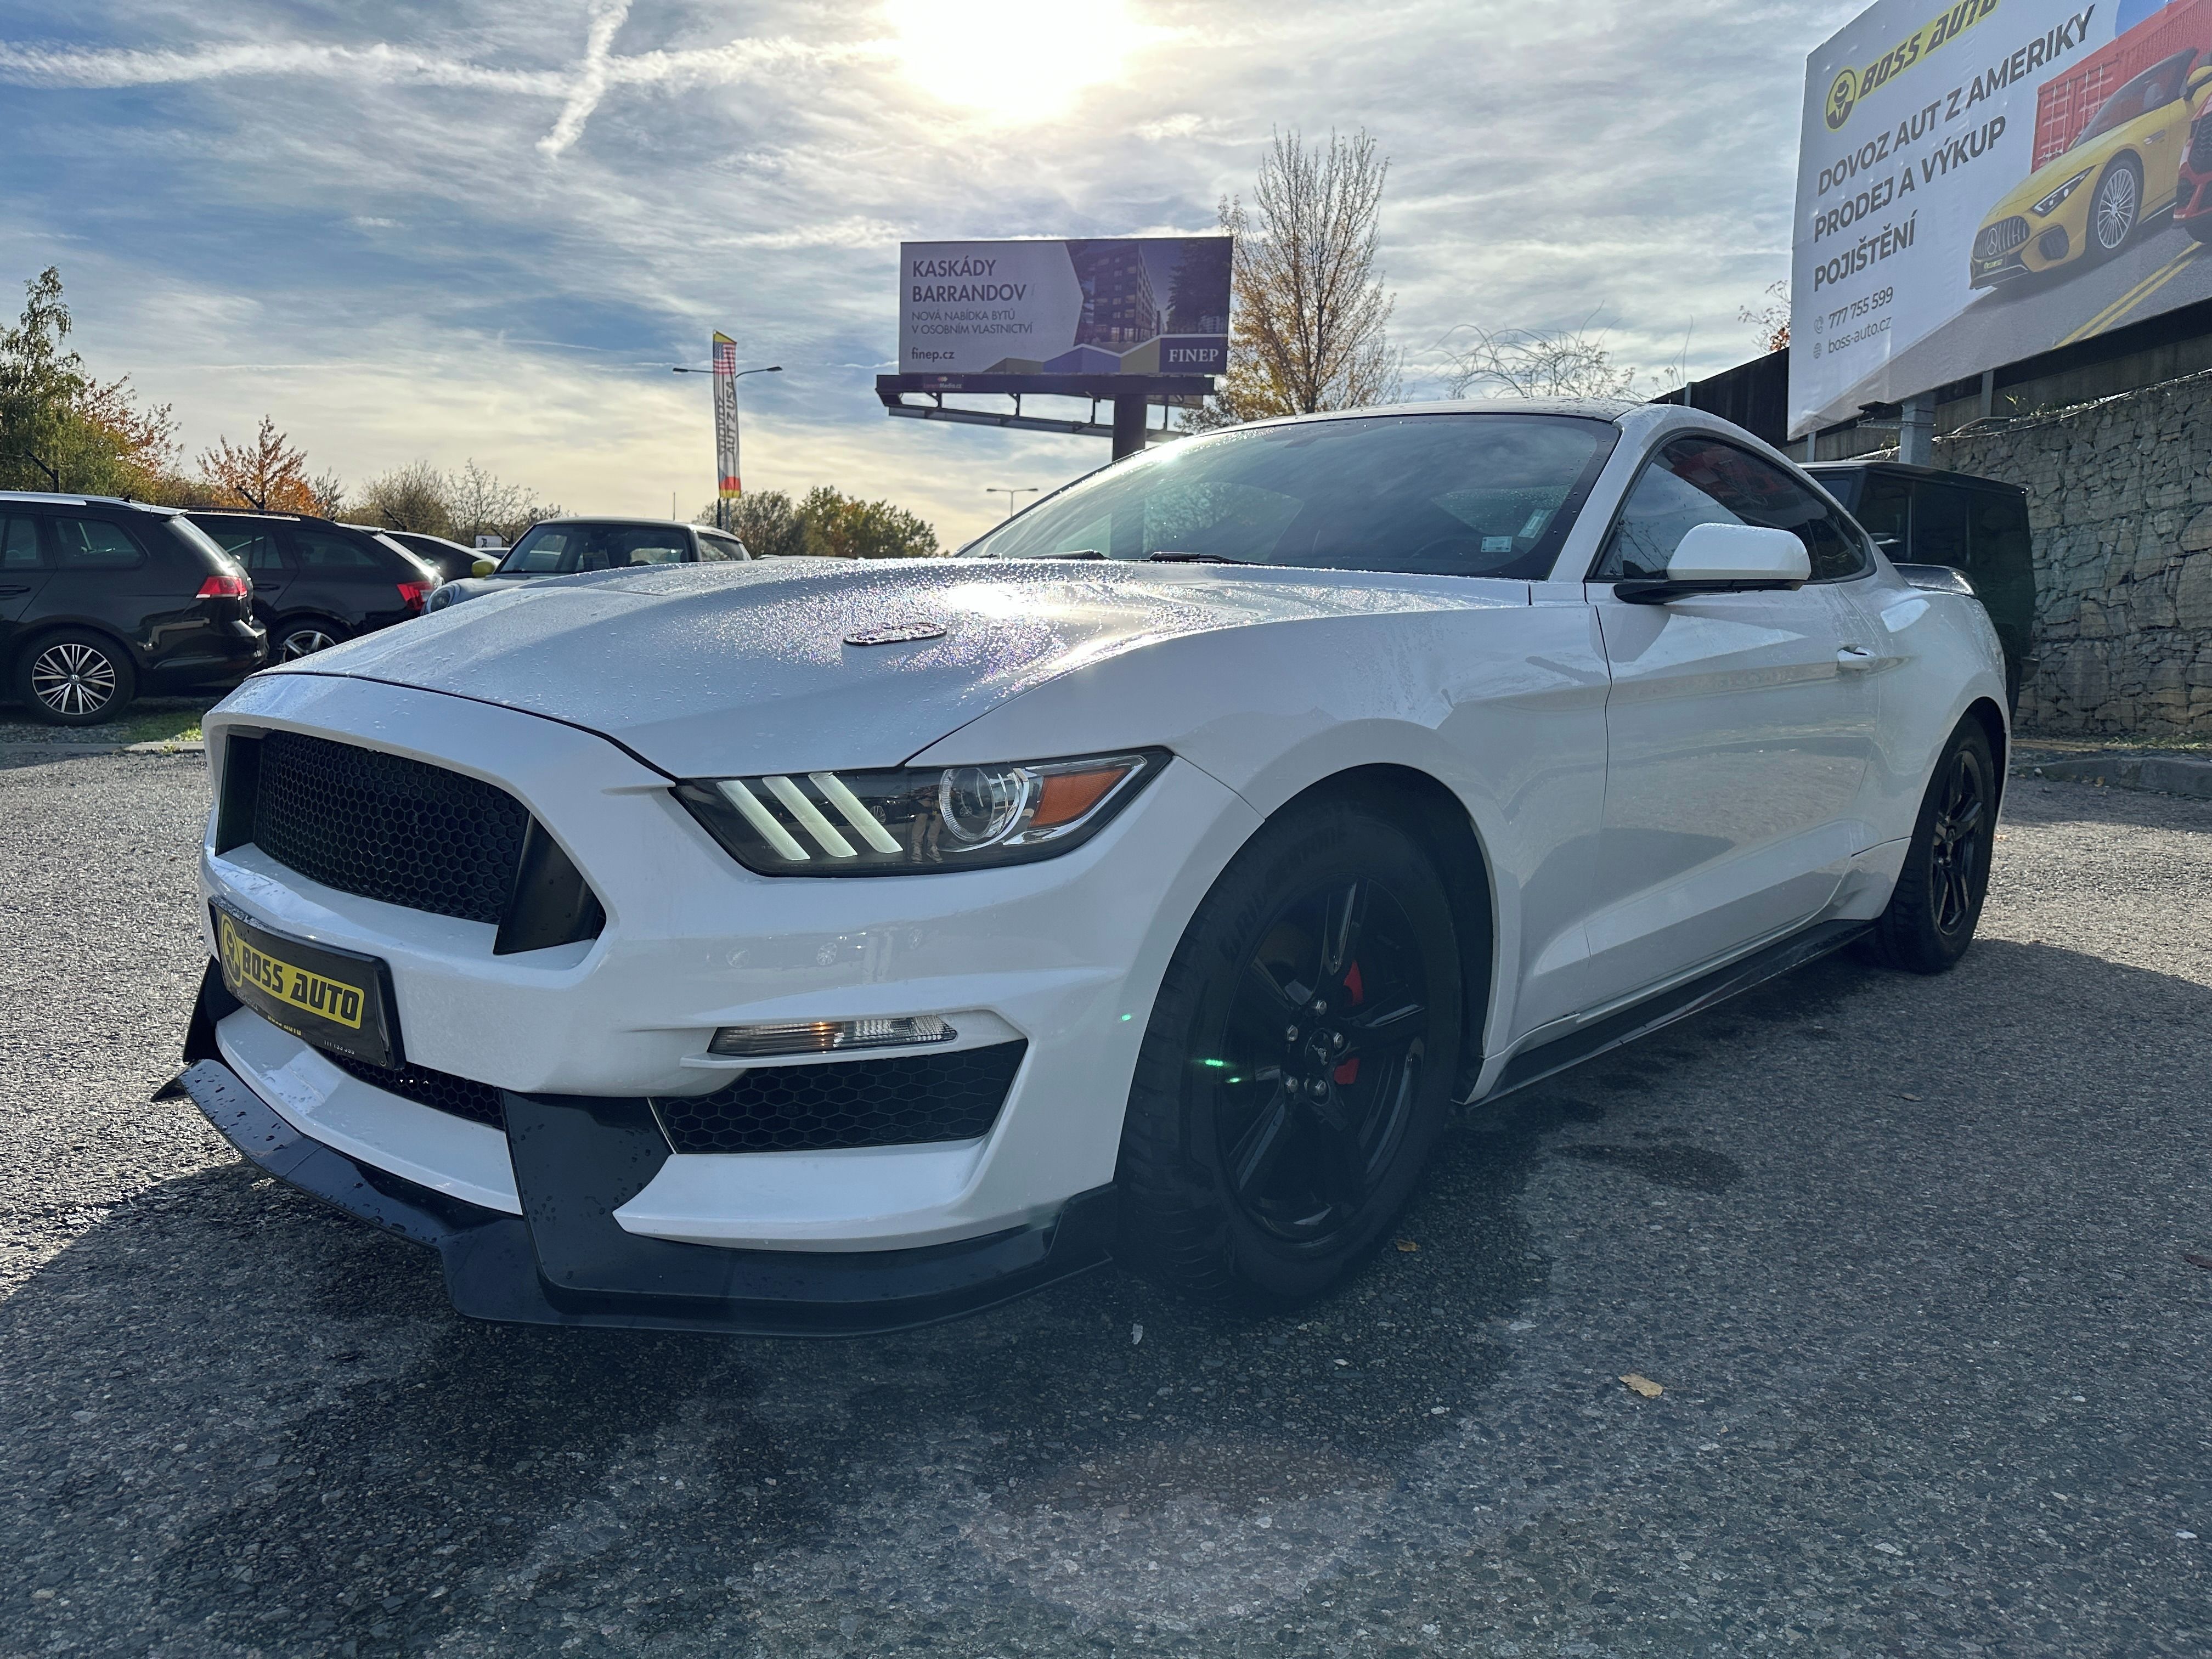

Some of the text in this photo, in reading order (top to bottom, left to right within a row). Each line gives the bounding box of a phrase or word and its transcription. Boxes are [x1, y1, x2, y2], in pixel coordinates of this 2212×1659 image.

[1858, 31, 1922, 100] BOSS
[1818, 3, 2096, 197] DOVOZ AUT Z AMERIKY
[1814, 116, 2006, 243] PRODEJ A VÝKUP
[912, 255, 997, 278] KASKÁDY
[1814, 209, 1918, 292] POJIŠTĚNÍ
[912, 284, 1027, 302] BARRANDOV
[1828, 286, 1893, 329] 777 755 599
[911, 308, 1015, 321] NOVÁ NABÍDKA BYTŮ
[911, 322, 1033, 335] V OSOBNÍM VLASTNICTVÍ
[911, 347, 955, 363] finep.cz
[1168, 348, 1218, 363] FINEP
[1828, 317, 1892, 354] boss-auto.cz
[725, 381, 736, 455] AUT Z USA
[242, 945, 284, 994] BOSS
[290, 972, 360, 1022] AUTO
